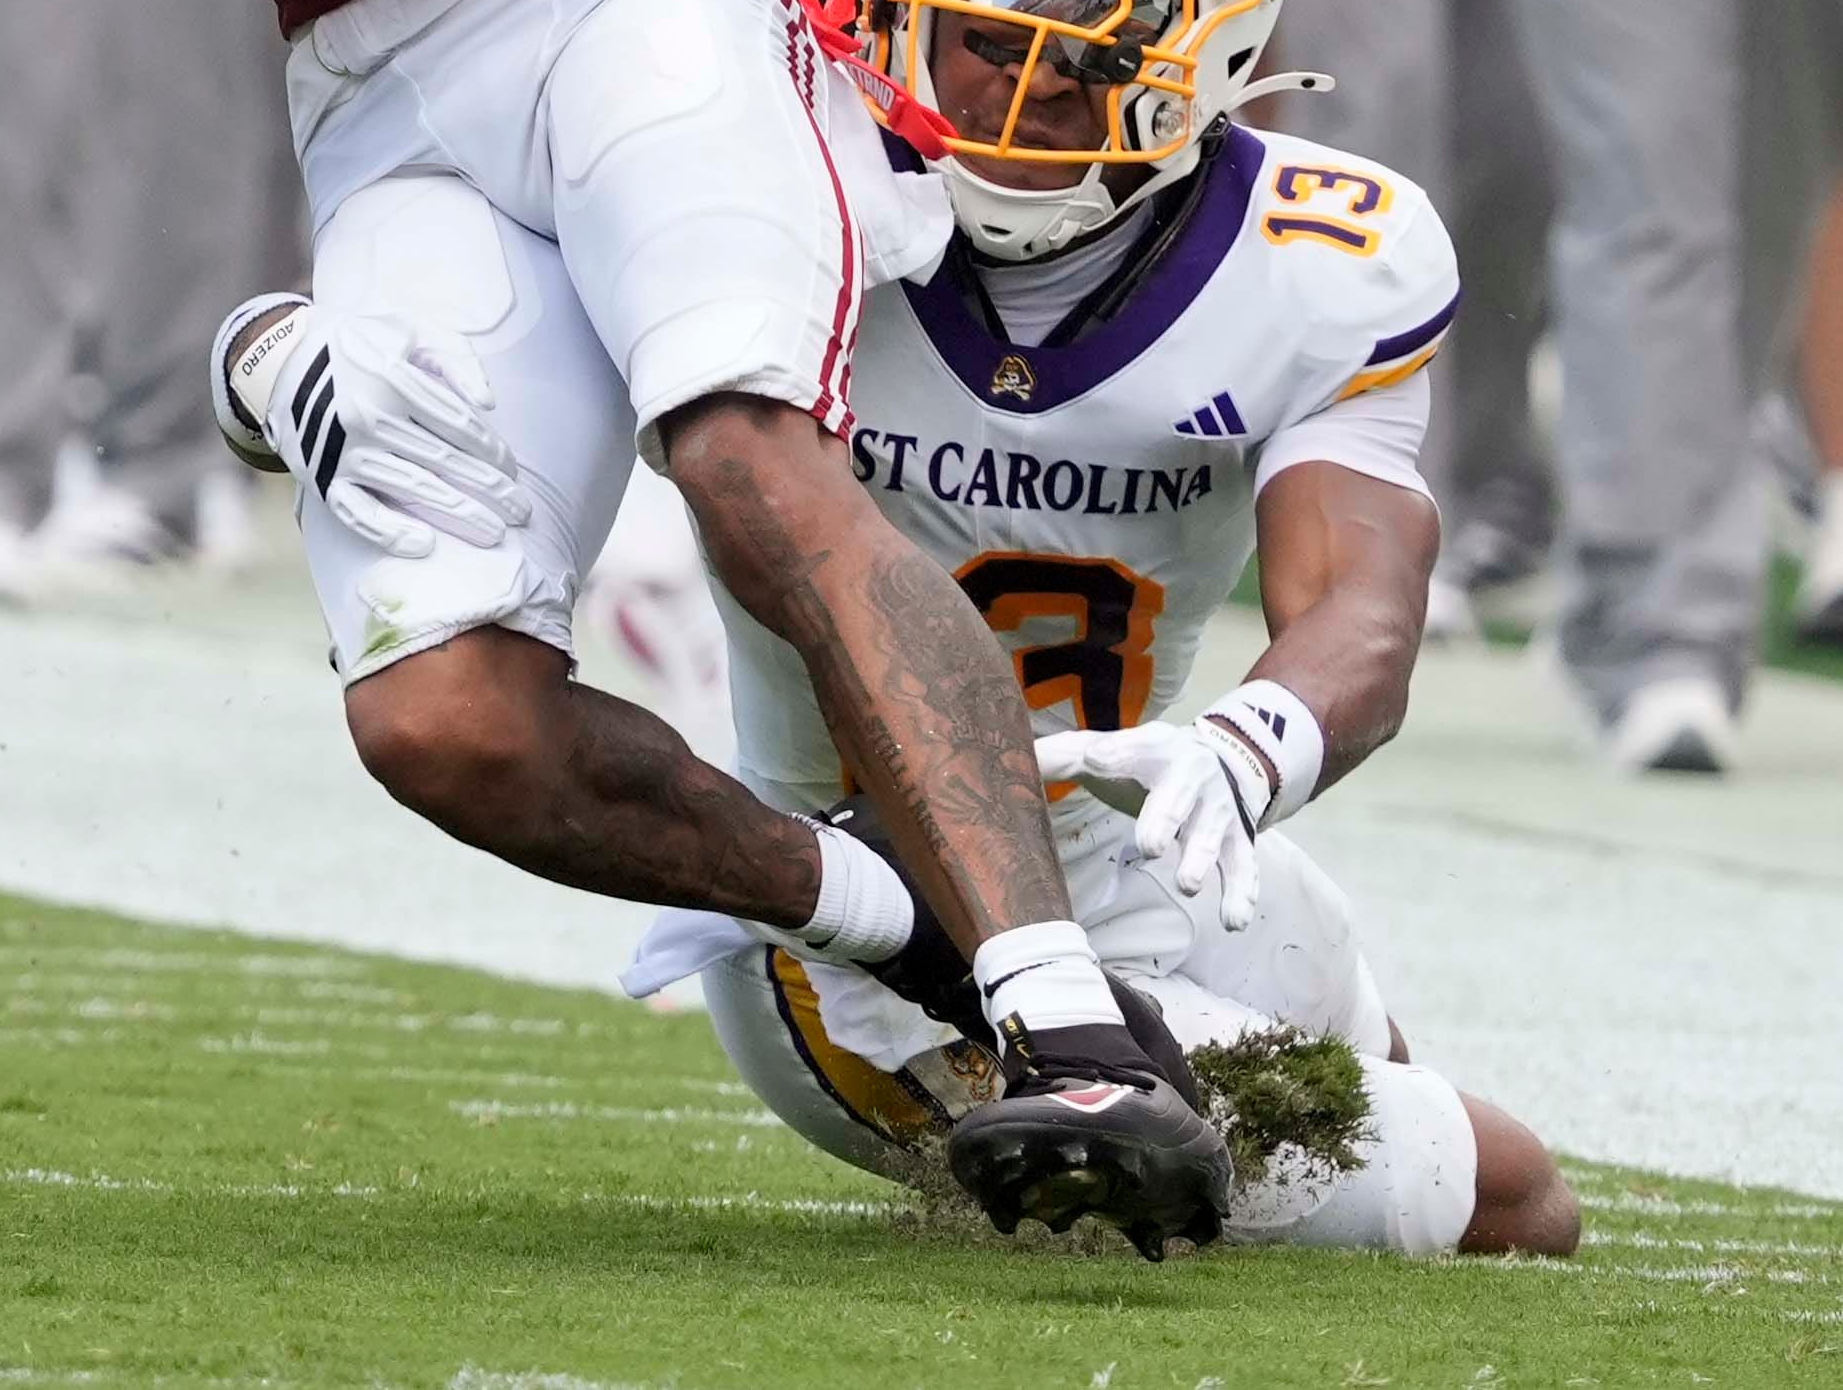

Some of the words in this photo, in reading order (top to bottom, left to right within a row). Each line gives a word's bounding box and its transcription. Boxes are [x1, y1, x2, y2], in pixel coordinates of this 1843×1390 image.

[1260, 162, 1396, 258] 13
[241, 320, 296, 377] ADIZERO
[928, 430, 1213, 514] CAROLINA
